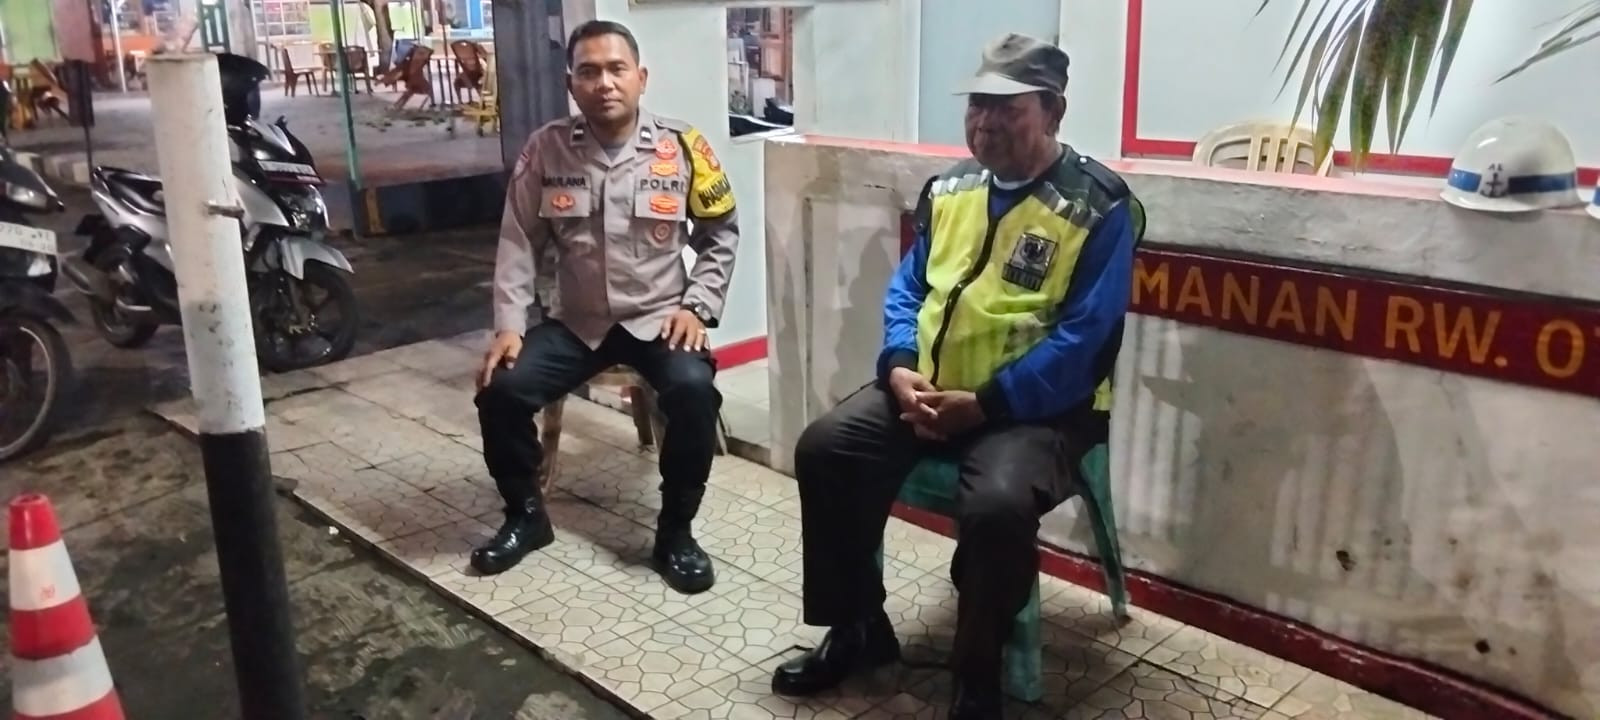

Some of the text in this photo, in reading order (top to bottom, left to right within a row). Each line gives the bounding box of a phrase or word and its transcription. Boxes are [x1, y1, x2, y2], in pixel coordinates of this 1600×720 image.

[640, 178, 685, 191] POLRI
[1131, 258, 1358, 342] MANAN
[1384, 295, 1508, 368] RW.
